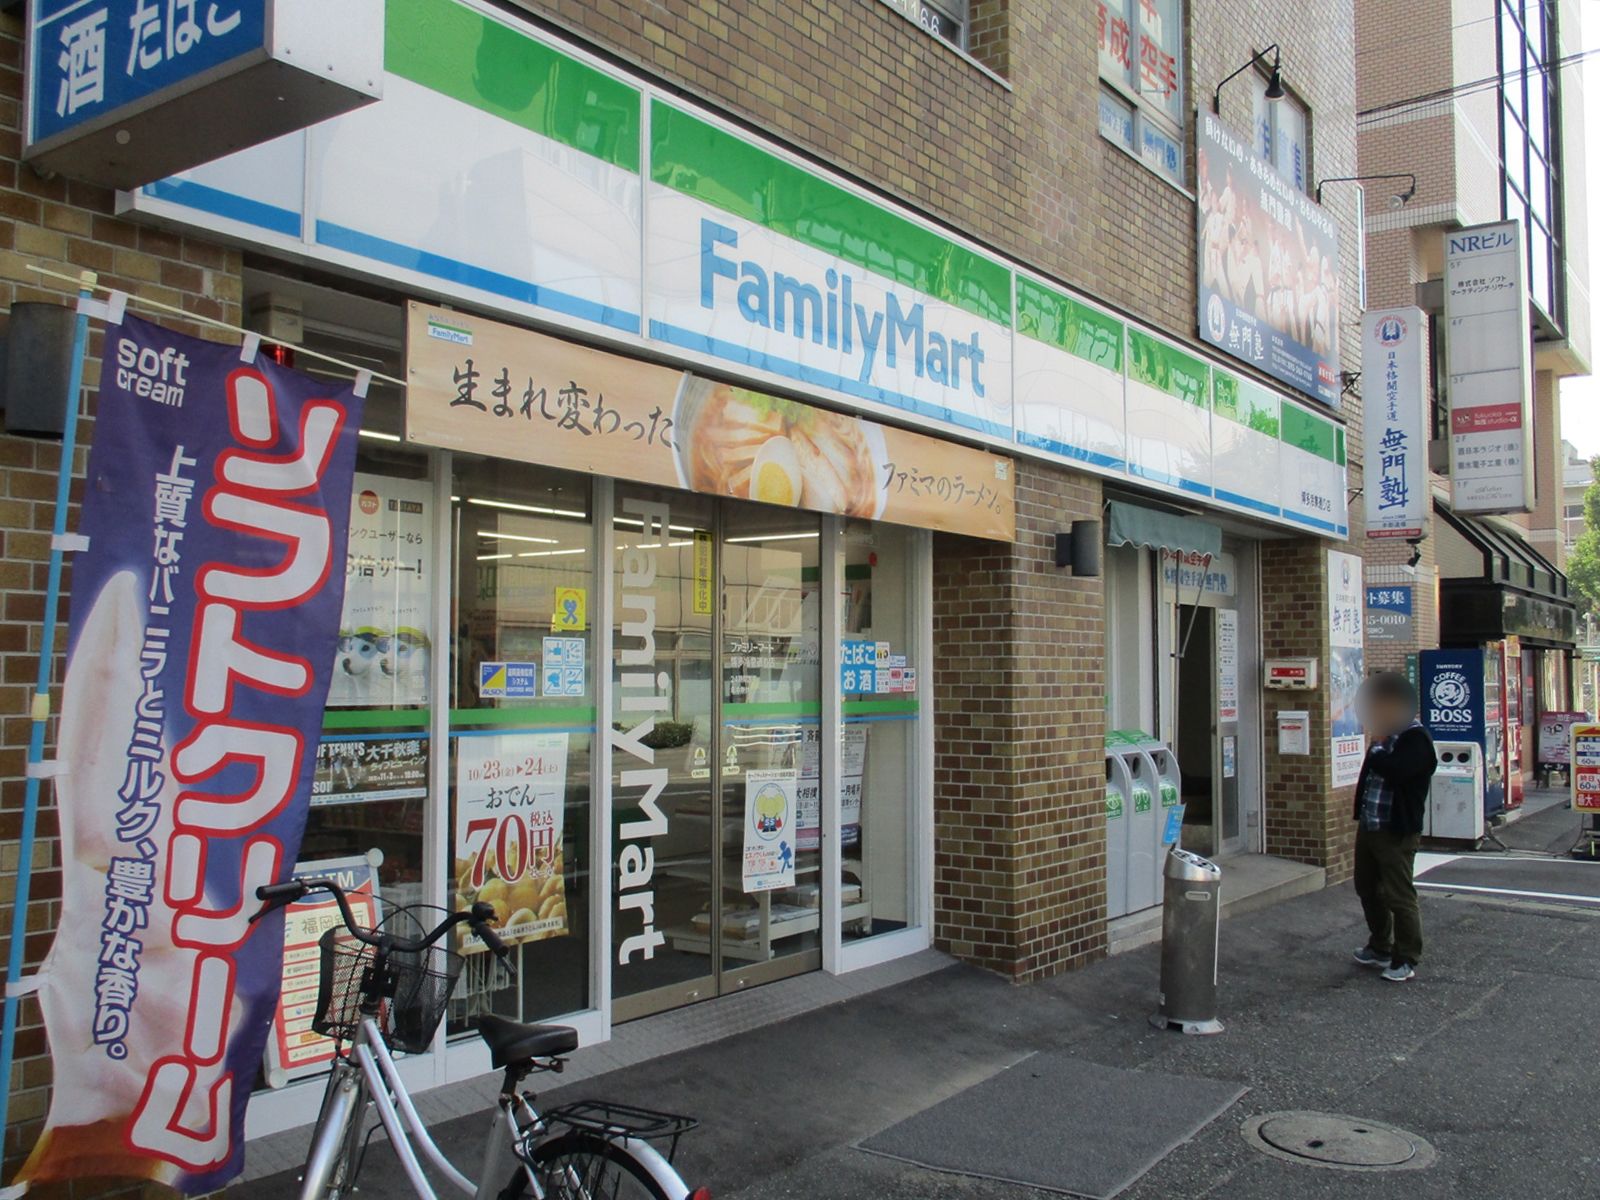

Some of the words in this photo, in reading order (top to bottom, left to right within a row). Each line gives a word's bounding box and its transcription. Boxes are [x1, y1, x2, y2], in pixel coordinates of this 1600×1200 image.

[56, 7, 108, 118] 酒
[1449, 232, 1514, 255] NRビル
[701, 217, 985, 399] FamilyMart
[432, 328, 469, 345] FamilyMart
[116, 338, 191, 387] soft
[116, 367, 185, 408] cream
[1378, 427, 1409, 511] 無門塾
[840, 643, 876, 665] たばこ
[843, 669, 872, 692] お酒
[1433, 671, 1467, 683] COFFEE
[1429, 708, 1473, 723] BOSS
[611, 498, 670, 966] FamilyMart
[366, 740, 420, 761] 大千秋楽
[485, 784, 536, 810] おでん
[530, 810, 554, 828] 税込
[464, 814, 556, 891] 70円
